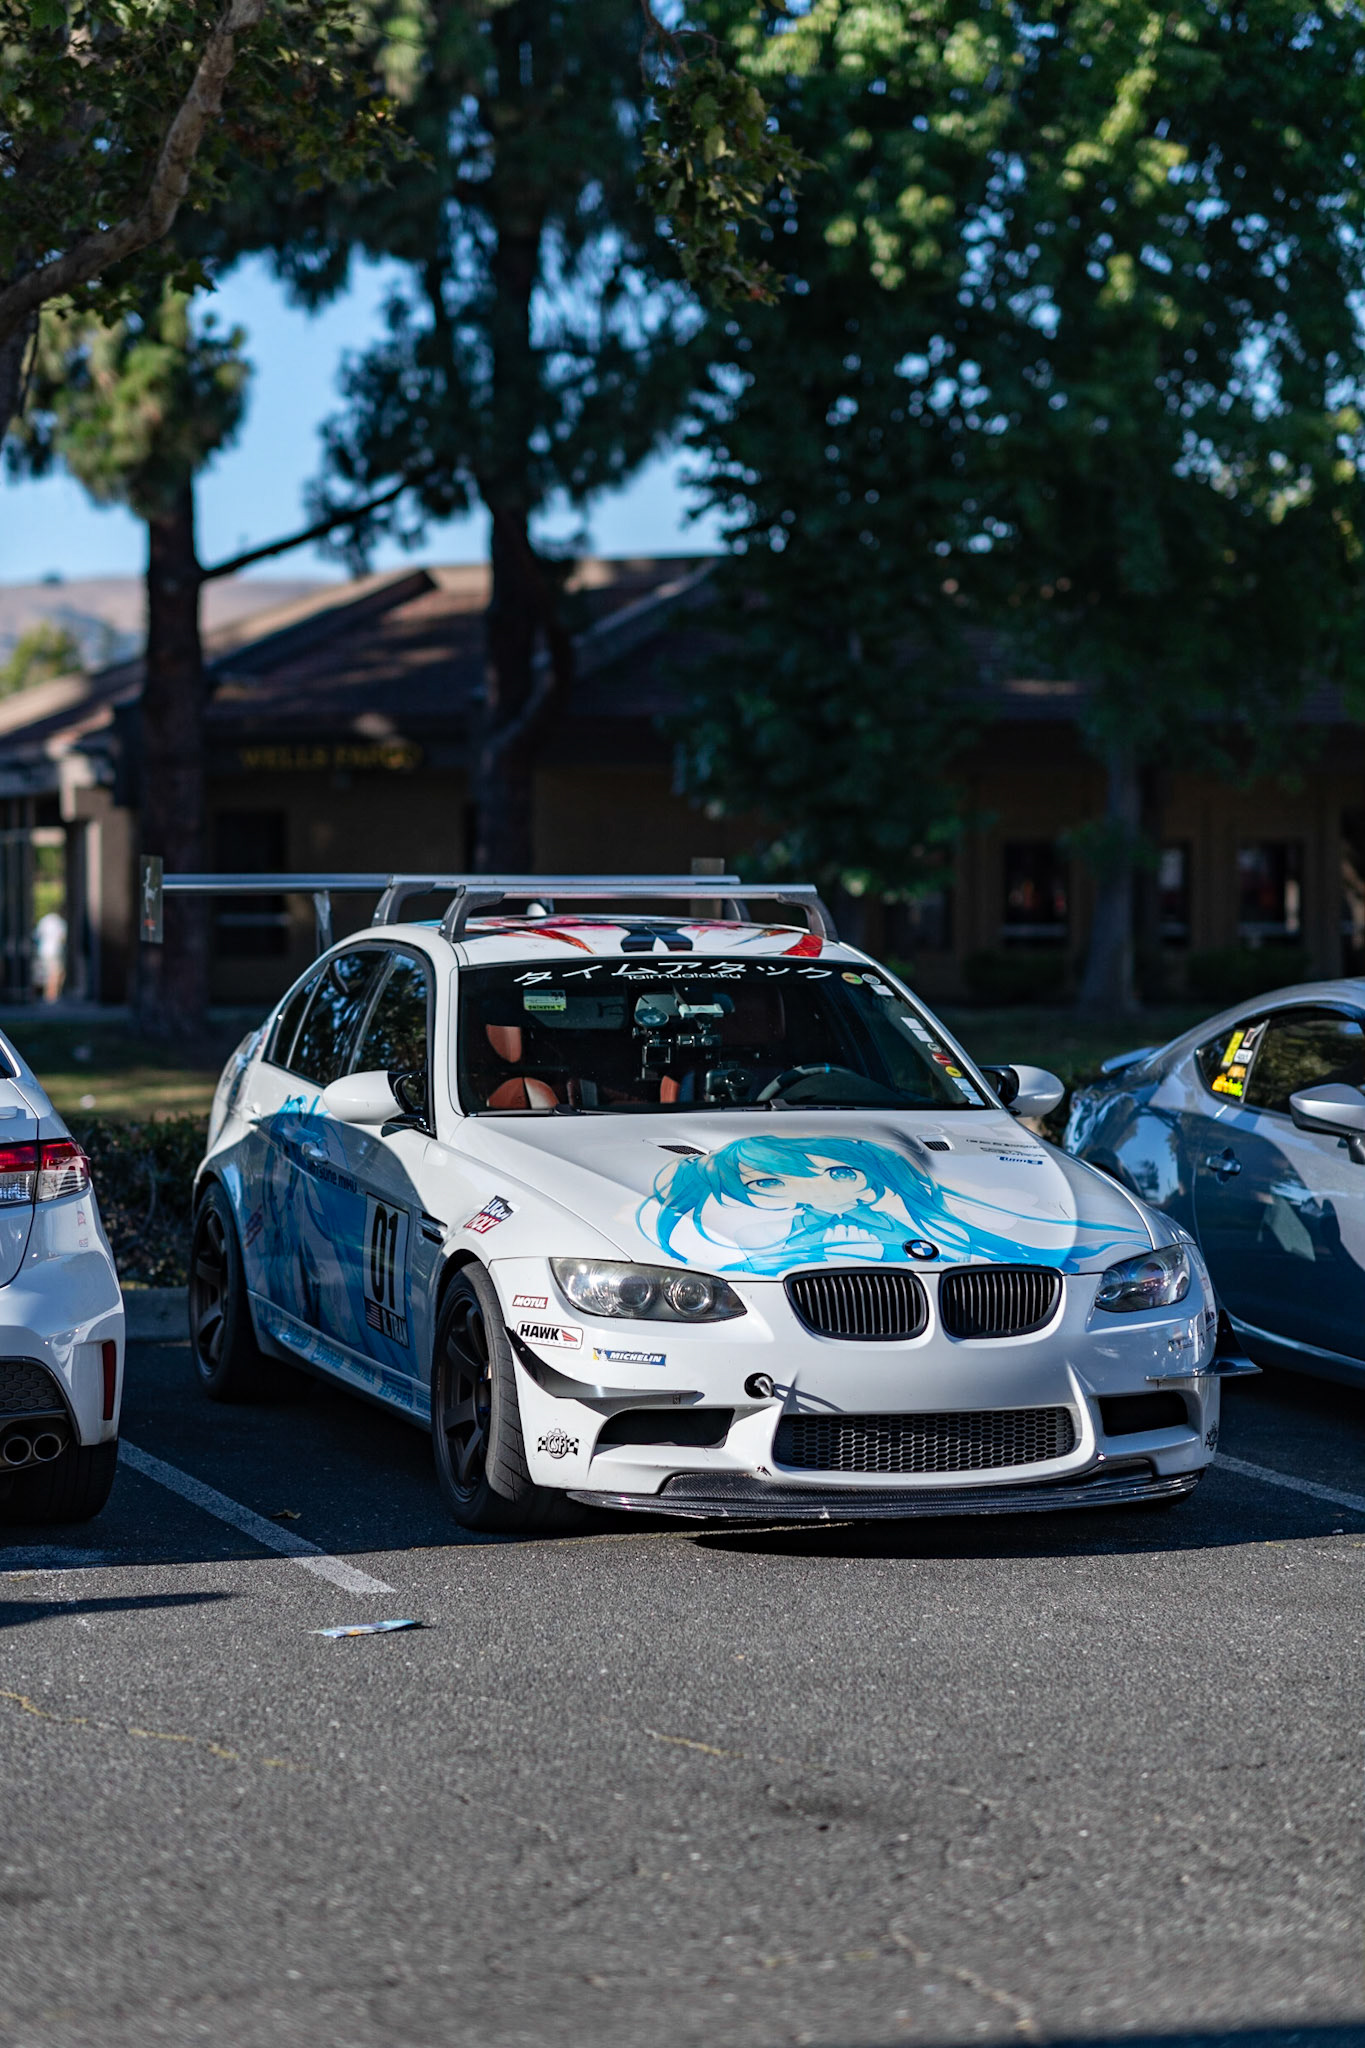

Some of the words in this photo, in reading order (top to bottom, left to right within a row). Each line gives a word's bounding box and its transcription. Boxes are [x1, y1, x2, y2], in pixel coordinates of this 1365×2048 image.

[513, 961, 833, 986] タイムアタック
[465, 1213, 499, 1232] MOLY
[371, 1202, 399, 1309] 01
[513, 1296, 546, 1308] MOTUL
[520, 1324, 560, 1341] HAWK
[609, 1352, 662, 1363] MICHELIN
[548, 1435, 566, 1454] CSF
